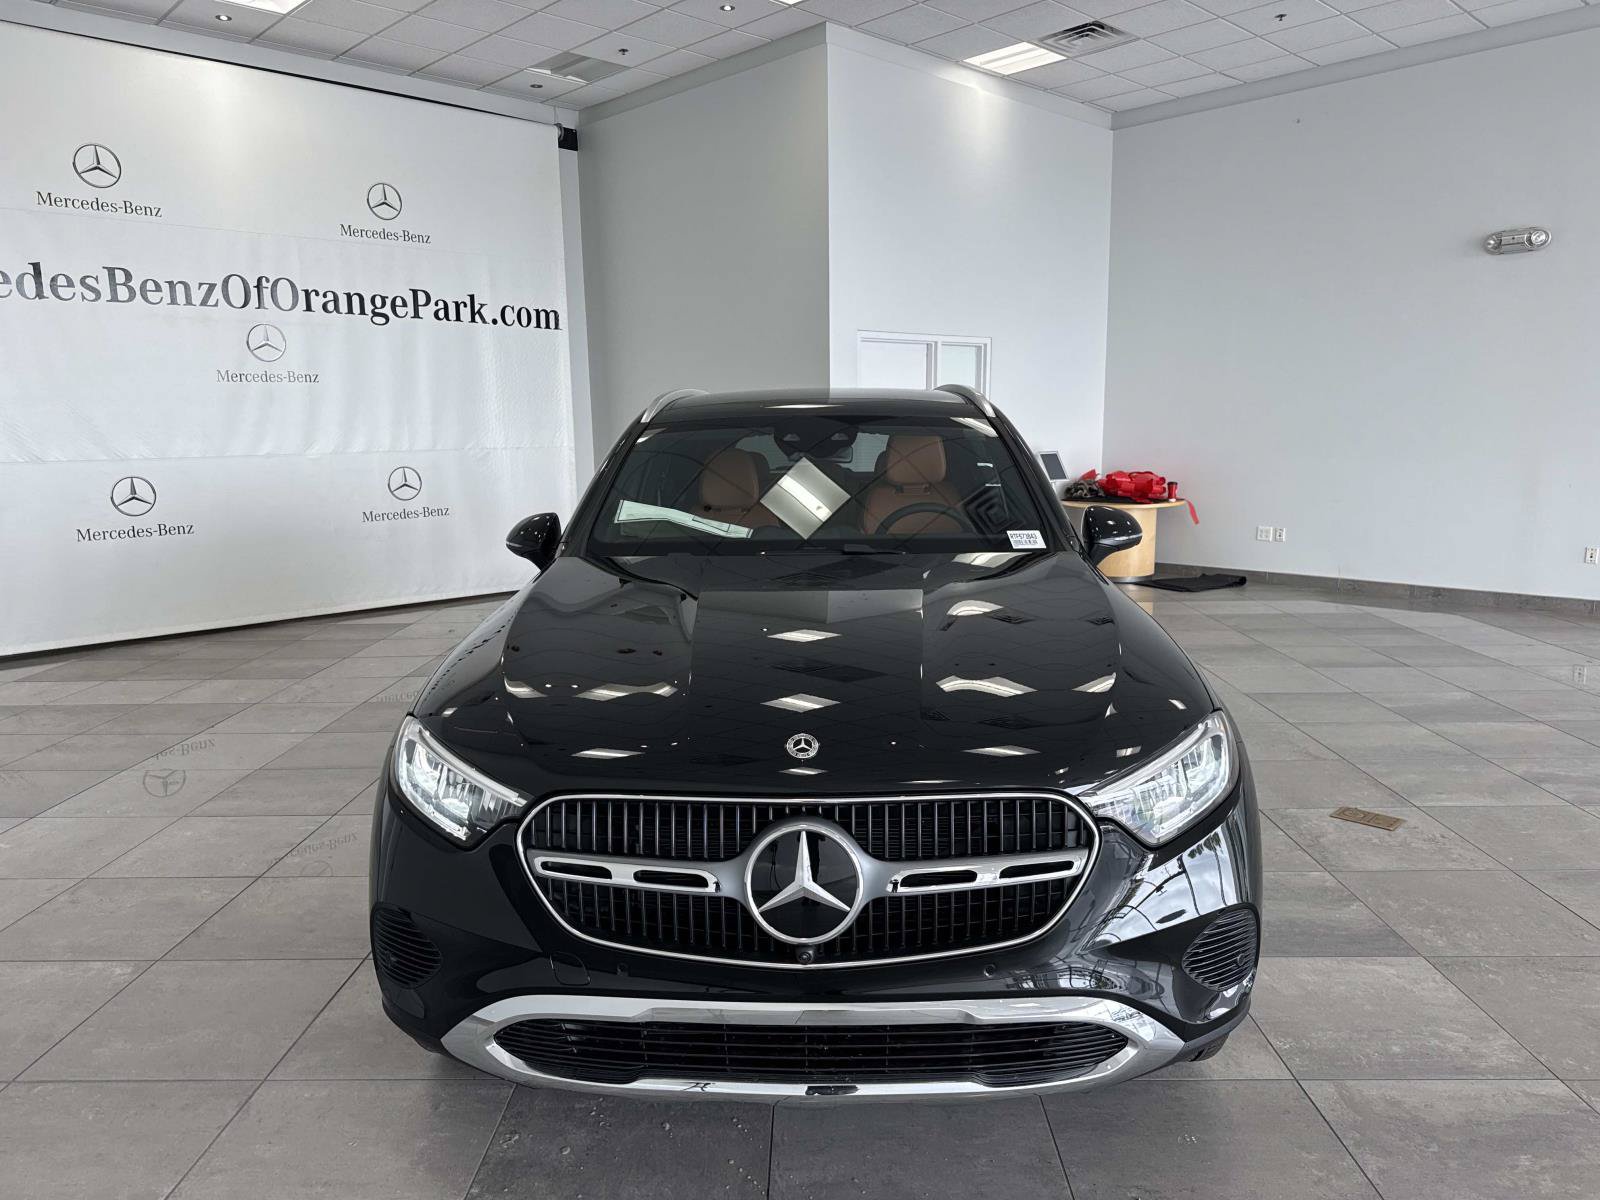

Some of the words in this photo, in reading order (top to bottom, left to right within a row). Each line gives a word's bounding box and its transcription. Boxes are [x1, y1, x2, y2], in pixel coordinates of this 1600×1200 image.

[36, 190, 163, 218] Mercedes-Benz
[340, 223, 432, 245] Mercedes-Benz
[216, 369, 320, 385] Mercedes-Benz
[362, 506, 450, 523] Mercedes-Benz
[75, 523, 195, 543] Mercedes-Benz
